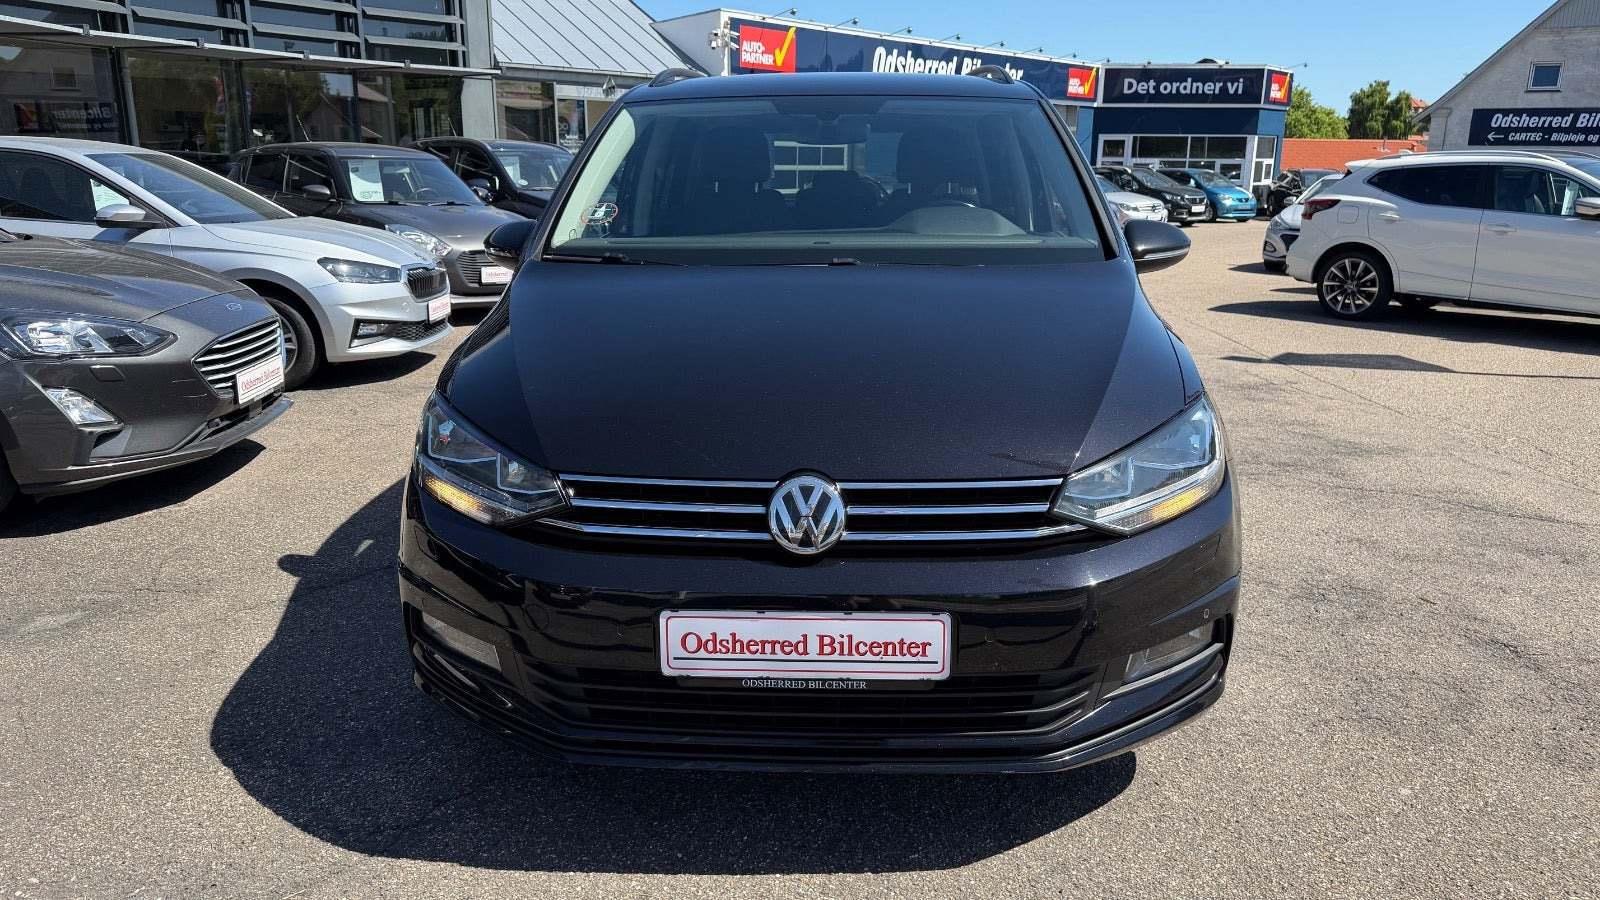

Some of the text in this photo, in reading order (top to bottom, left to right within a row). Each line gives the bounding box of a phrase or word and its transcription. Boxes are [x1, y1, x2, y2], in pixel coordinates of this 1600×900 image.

[742, 40, 766, 53] AUTO-
[741, 51, 774, 65] PARTNER
[1123, 77, 1244, 94] Det ordner vi
[1490, 113, 1574, 128] Odsherred
[1508, 132, 1542, 141] CARTEC
[1550, 132, 1586, 143] Bilpleje
[1587, 135, 1599, 143] og
[680, 632, 932, 658] Odsherred Bilcenter
[742, 678, 868, 690] ODSHERRED BILCENTER
